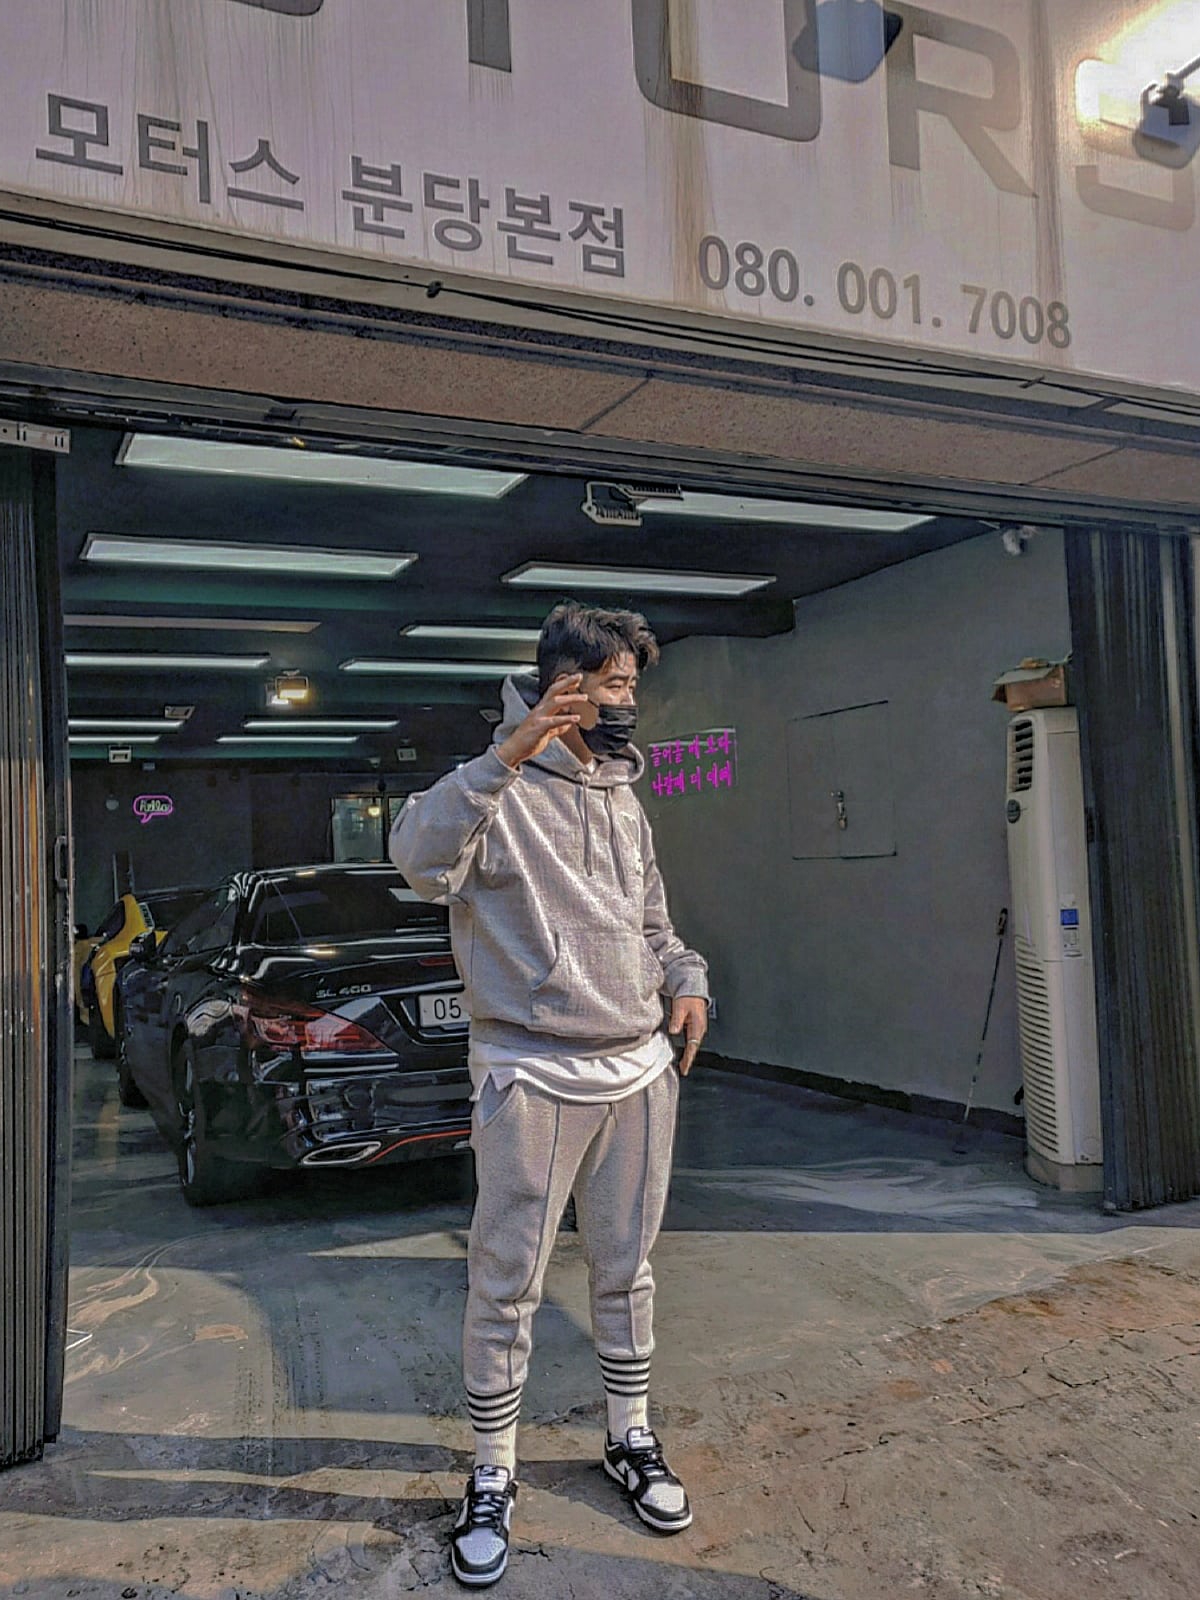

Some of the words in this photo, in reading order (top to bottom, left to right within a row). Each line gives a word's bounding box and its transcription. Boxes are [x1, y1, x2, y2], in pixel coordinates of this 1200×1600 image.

[36, 93, 304, 210] 모터스
[342, 155, 625, 277] 분당본점
[961, 284, 1072, 349] 7008
